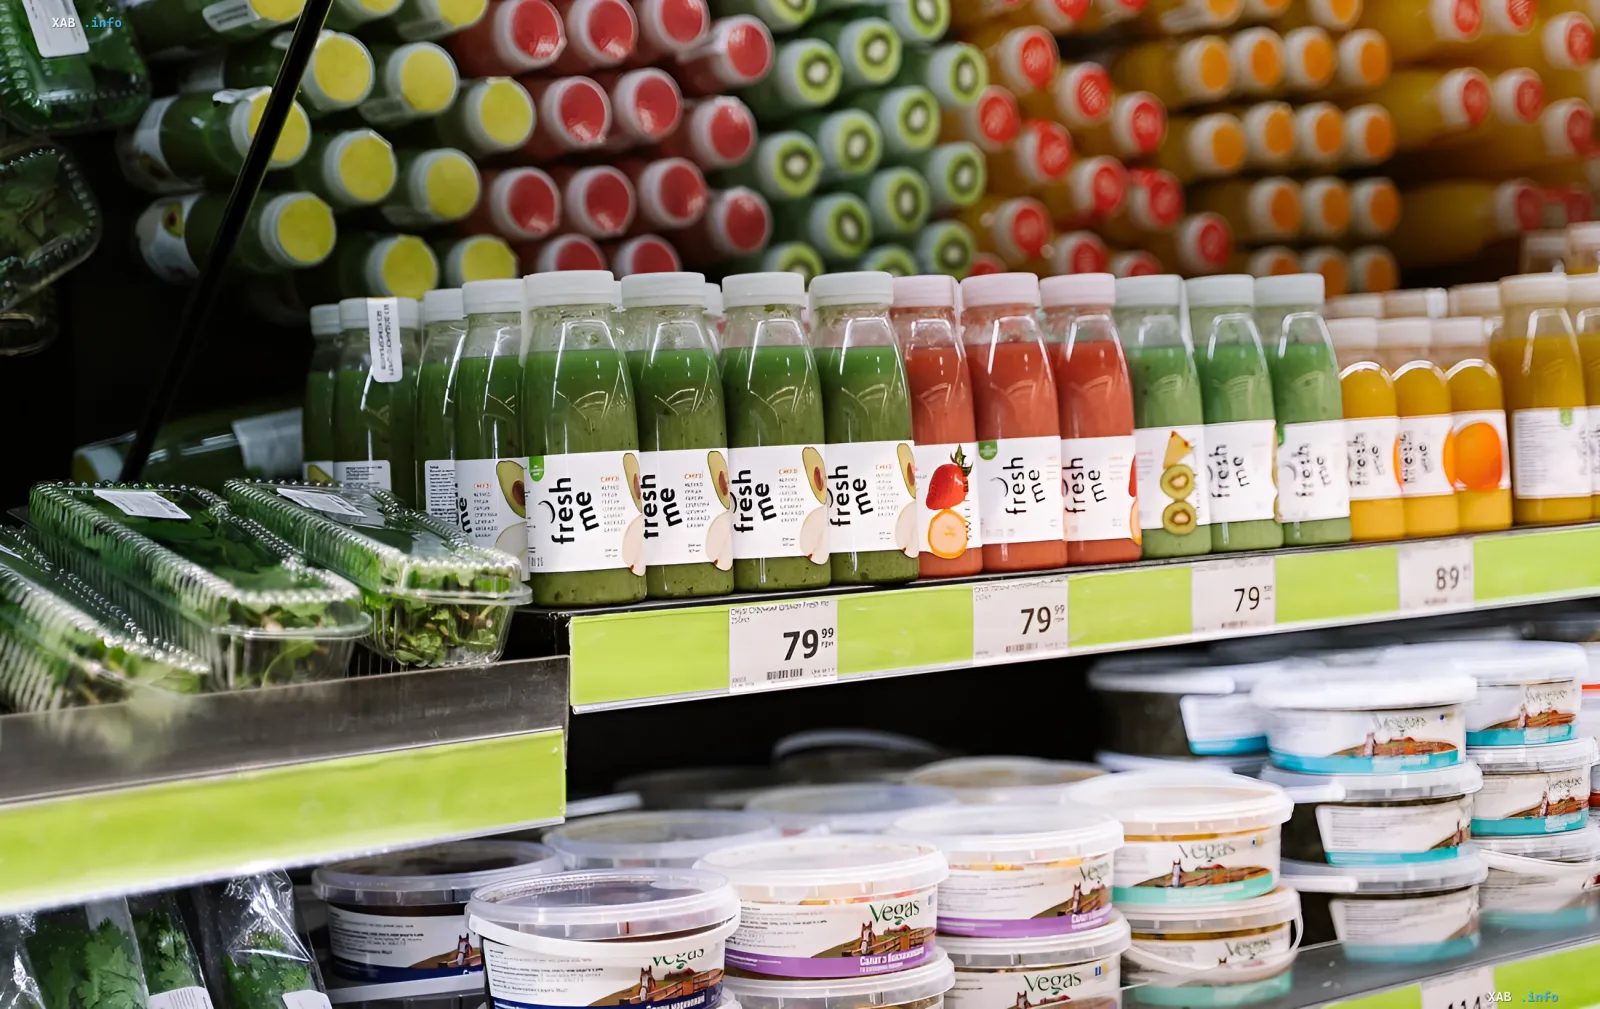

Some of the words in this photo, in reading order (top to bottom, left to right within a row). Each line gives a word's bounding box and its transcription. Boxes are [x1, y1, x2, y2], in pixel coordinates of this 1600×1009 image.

[1003, 457, 1027, 515] fresh
[1028, 469, 1046, 503] me
[1062, 457, 1087, 515] fresh
[1088, 469, 1108, 503] me
[1209, 444, 1231, 498] fresh
[549, 477, 575, 545] fresh
[575, 491, 600, 532] me
[660, 488, 683, 527] me
[731, 469, 754, 533] fresh
[755, 483, 777, 521] me
[828, 465, 851, 527] fresh
[852, 478, 874, 516] me
[1436, 564, 1459, 591] 89
[1234, 586, 1260, 612] 79
[1021, 606, 1051, 635] 79
[1054, 604, 1065, 615] 99
[783, 629, 819, 661] 79
[821, 627, 834, 639] 99
[1178, 841, 1236, 862] Vegas
[869, 900, 920, 925] Vegas
[1023, 971, 1082, 995] Vegas
